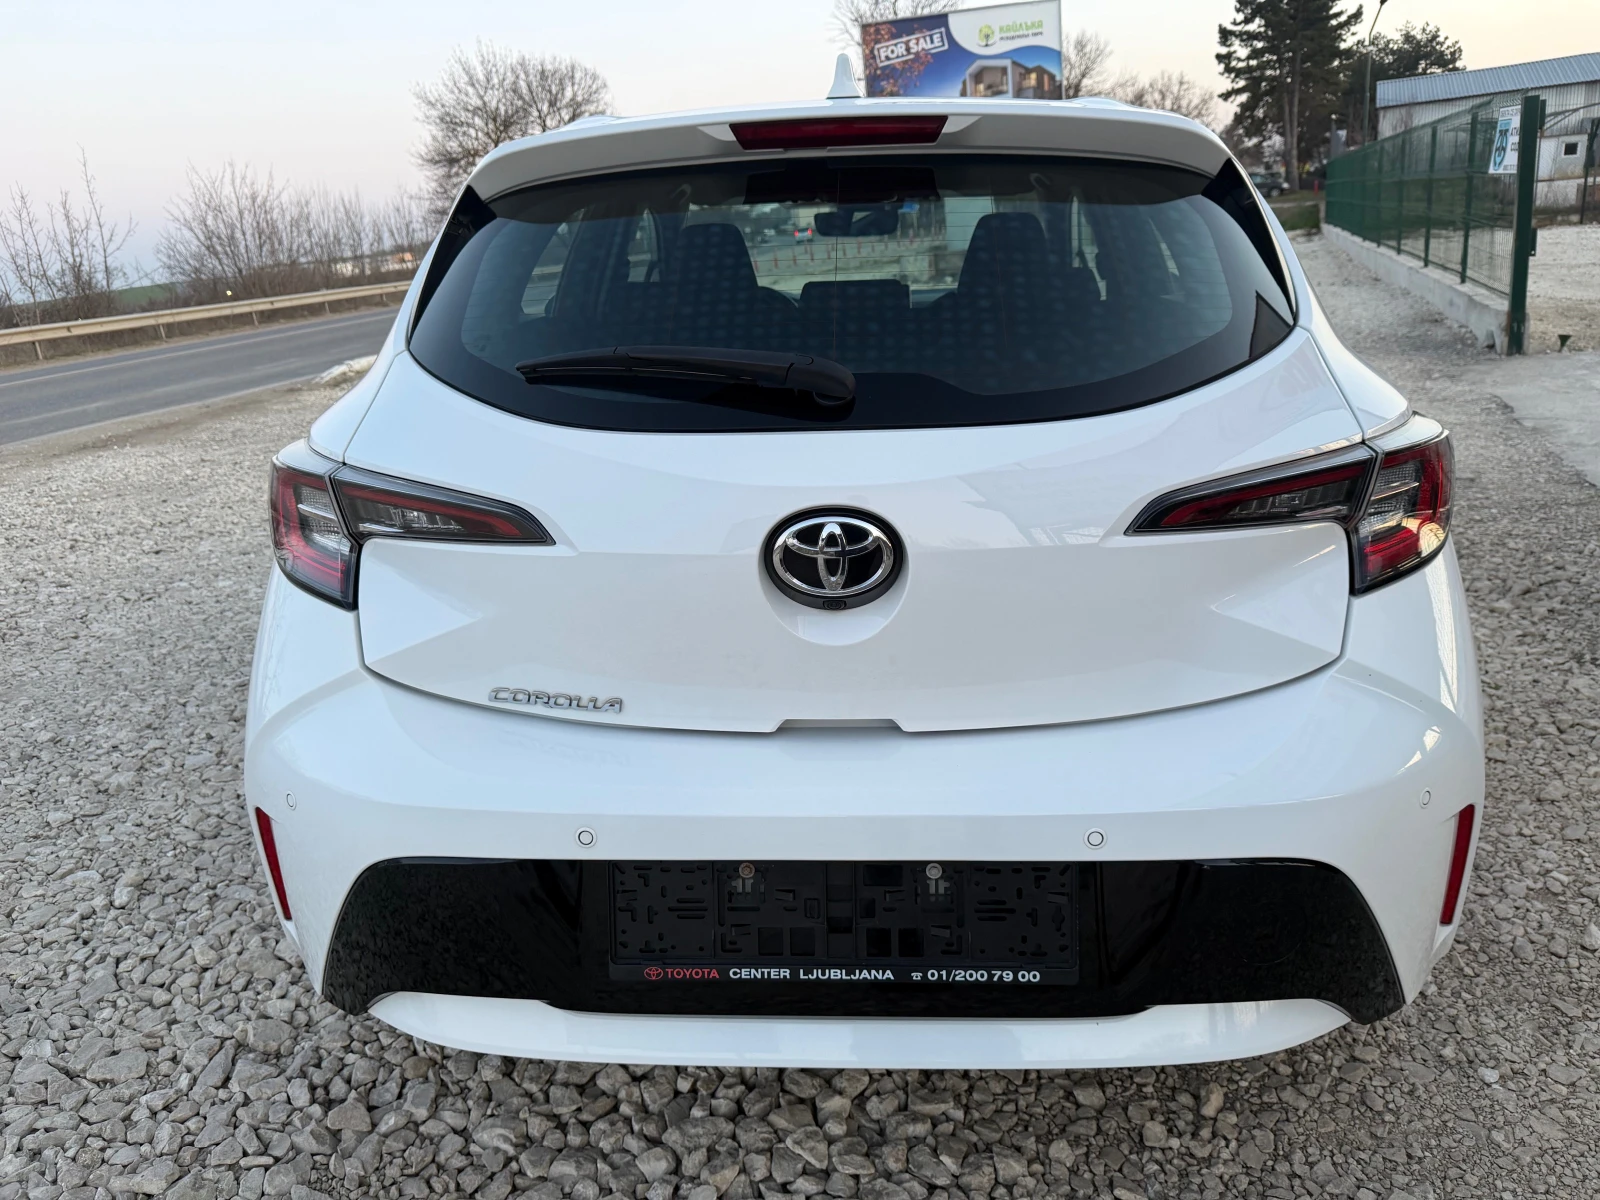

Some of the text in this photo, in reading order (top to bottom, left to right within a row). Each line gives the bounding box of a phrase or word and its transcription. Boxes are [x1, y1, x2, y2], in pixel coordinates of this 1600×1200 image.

[879, 33, 943, 62] FOR SALE
[488, 686, 623, 714] COROLLA
[666, 968, 1041, 983] TOYOTA CENTER LJUBLJANA 01/200 79 00
